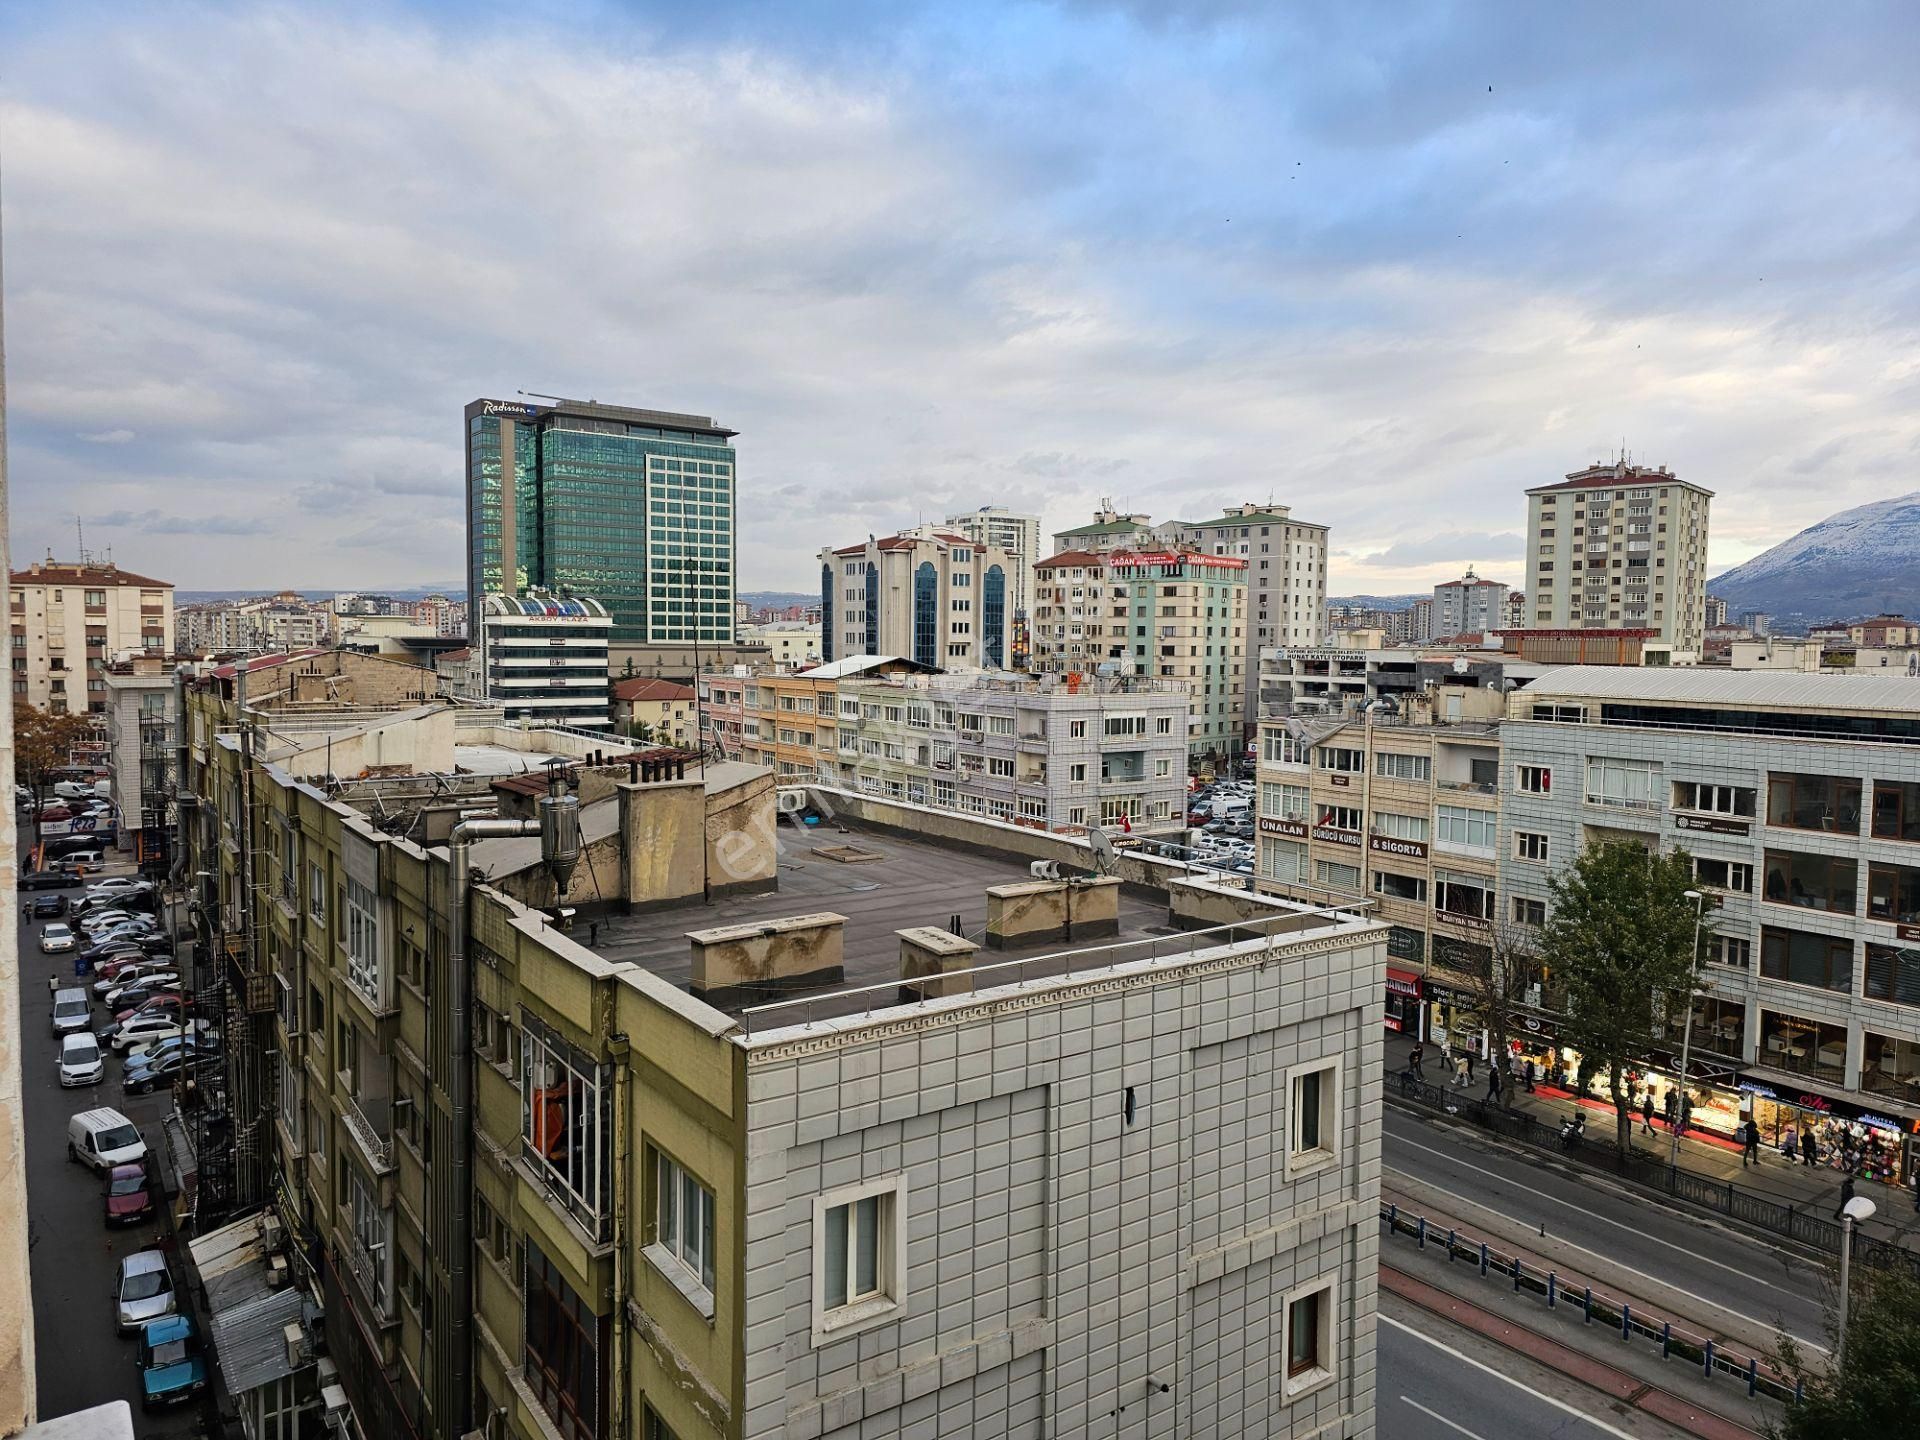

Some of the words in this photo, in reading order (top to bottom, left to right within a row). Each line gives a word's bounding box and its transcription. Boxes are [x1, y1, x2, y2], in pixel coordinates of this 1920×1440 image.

[483, 400, 526, 415] Radisson
[1109, 557, 1135, 566] ÇAĞAN
[1261, 820, 1304, 836] ÜNALAN
[1312, 828, 1338, 842] SÜRÜCÜ
[1339, 833, 1361, 845] KURSU
[1372, 839, 1380, 849] &
[1381, 841, 1423, 856] SİGORTA
[1467, 919, 1489, 931] EMLAK
[1433, 986, 1455, 998] black
[1799, 1092, 1833, 1112] She
